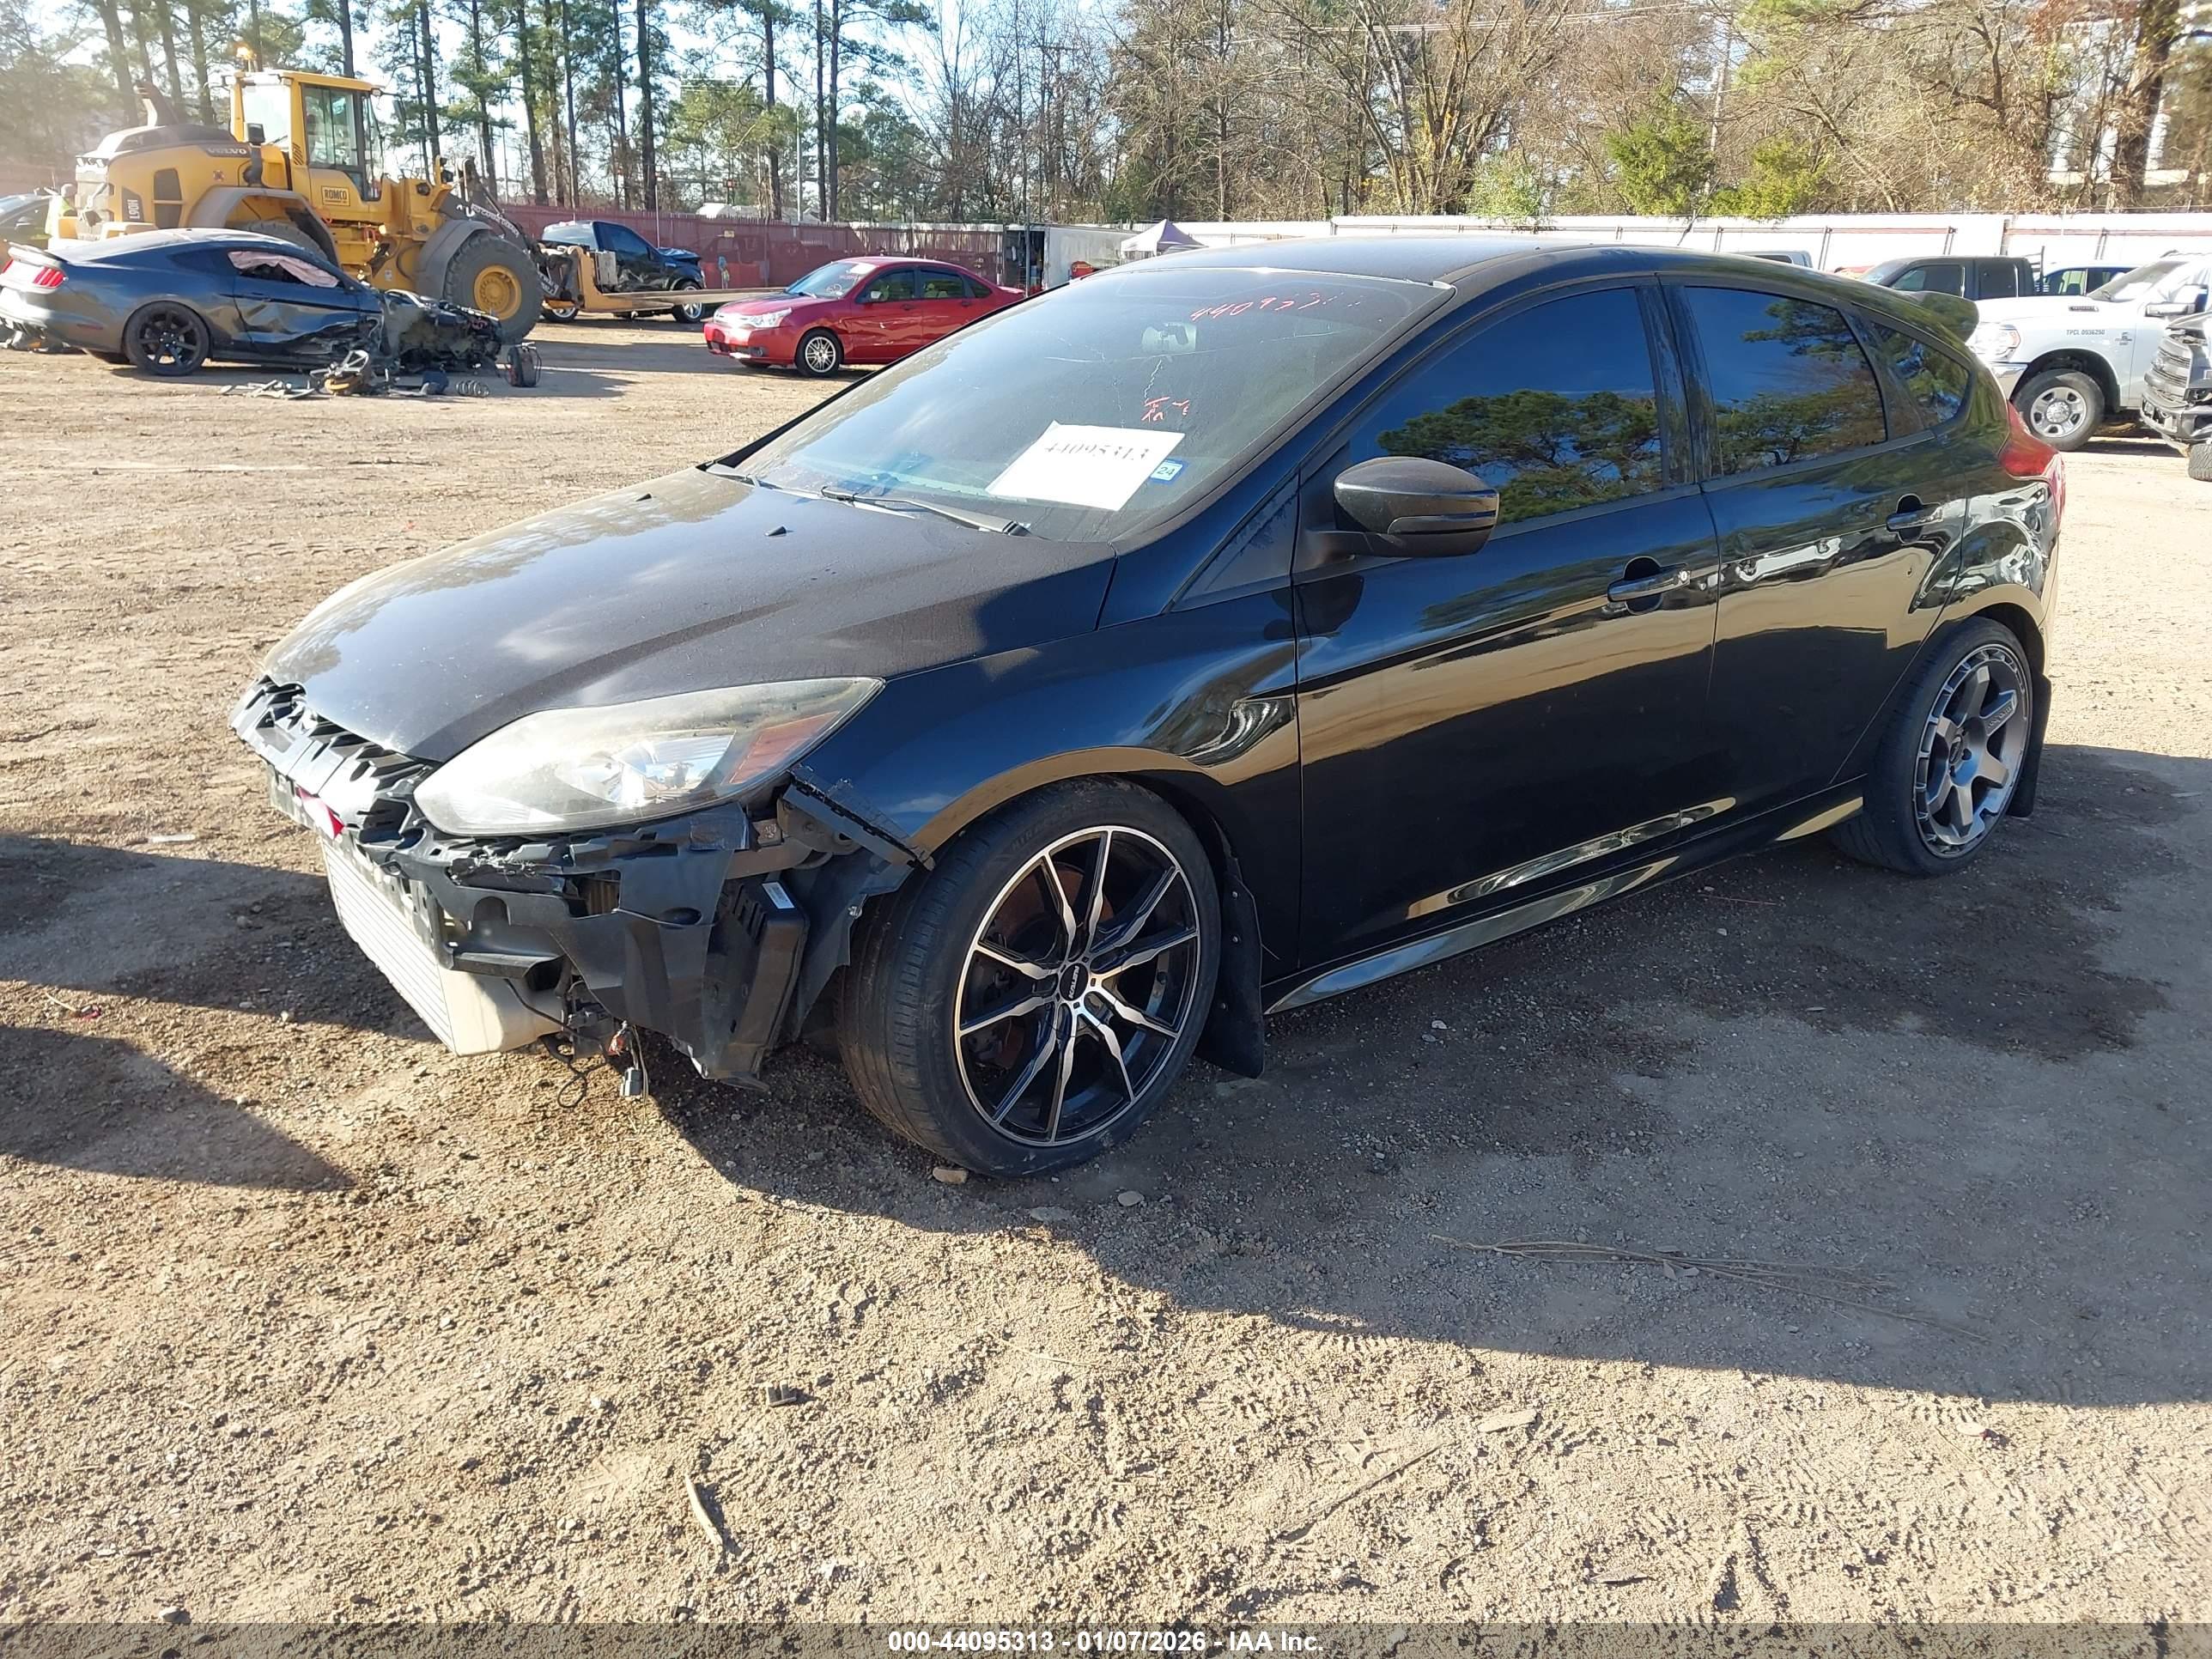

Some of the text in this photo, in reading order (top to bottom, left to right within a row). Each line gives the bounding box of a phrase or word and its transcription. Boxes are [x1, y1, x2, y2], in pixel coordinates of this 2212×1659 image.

[208, 147, 247, 155] VOLVO
[324, 188, 348, 200] ROMCO
[1157, 466, 1176, 477] 24
